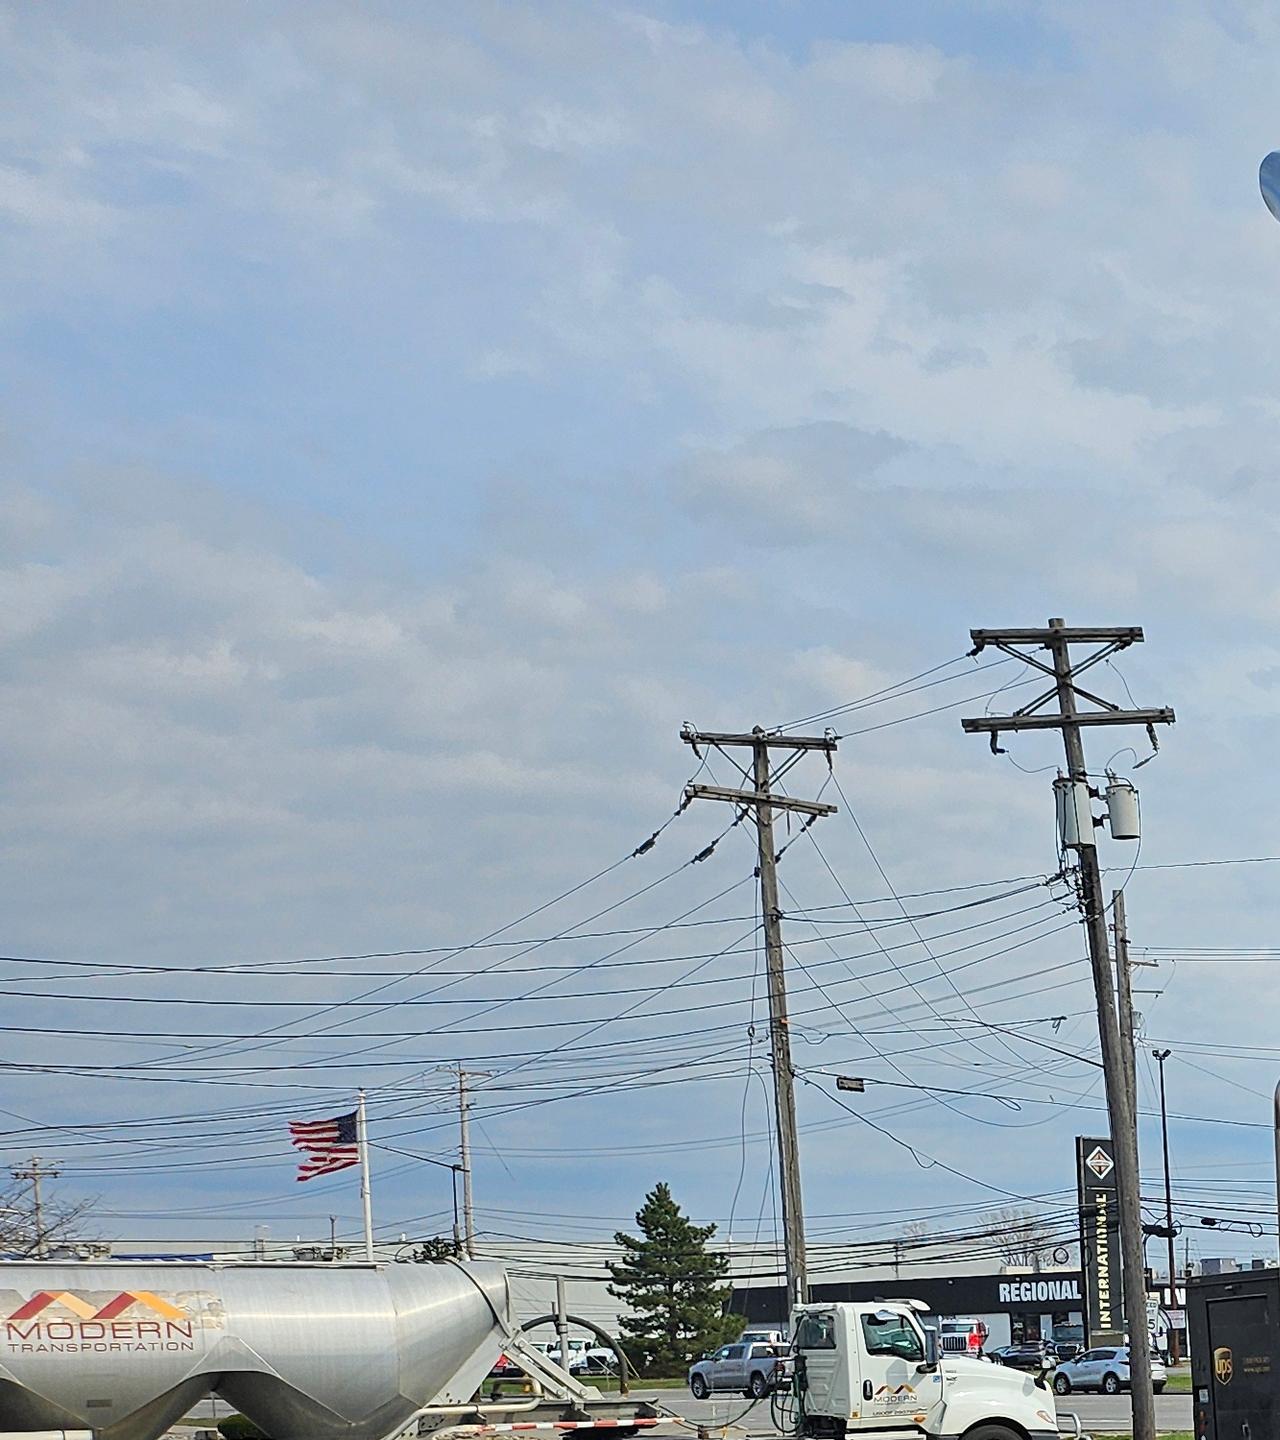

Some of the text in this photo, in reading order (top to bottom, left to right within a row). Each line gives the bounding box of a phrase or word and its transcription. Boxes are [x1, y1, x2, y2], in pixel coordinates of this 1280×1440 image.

[1000, 1280, 1082, 1302] REGIONAL
[7, 1321, 193, 1340] MODERN
[1147, 1319, 1155, 1330] 5
[8, 1342, 194, 1353] TRANSPORTATION
